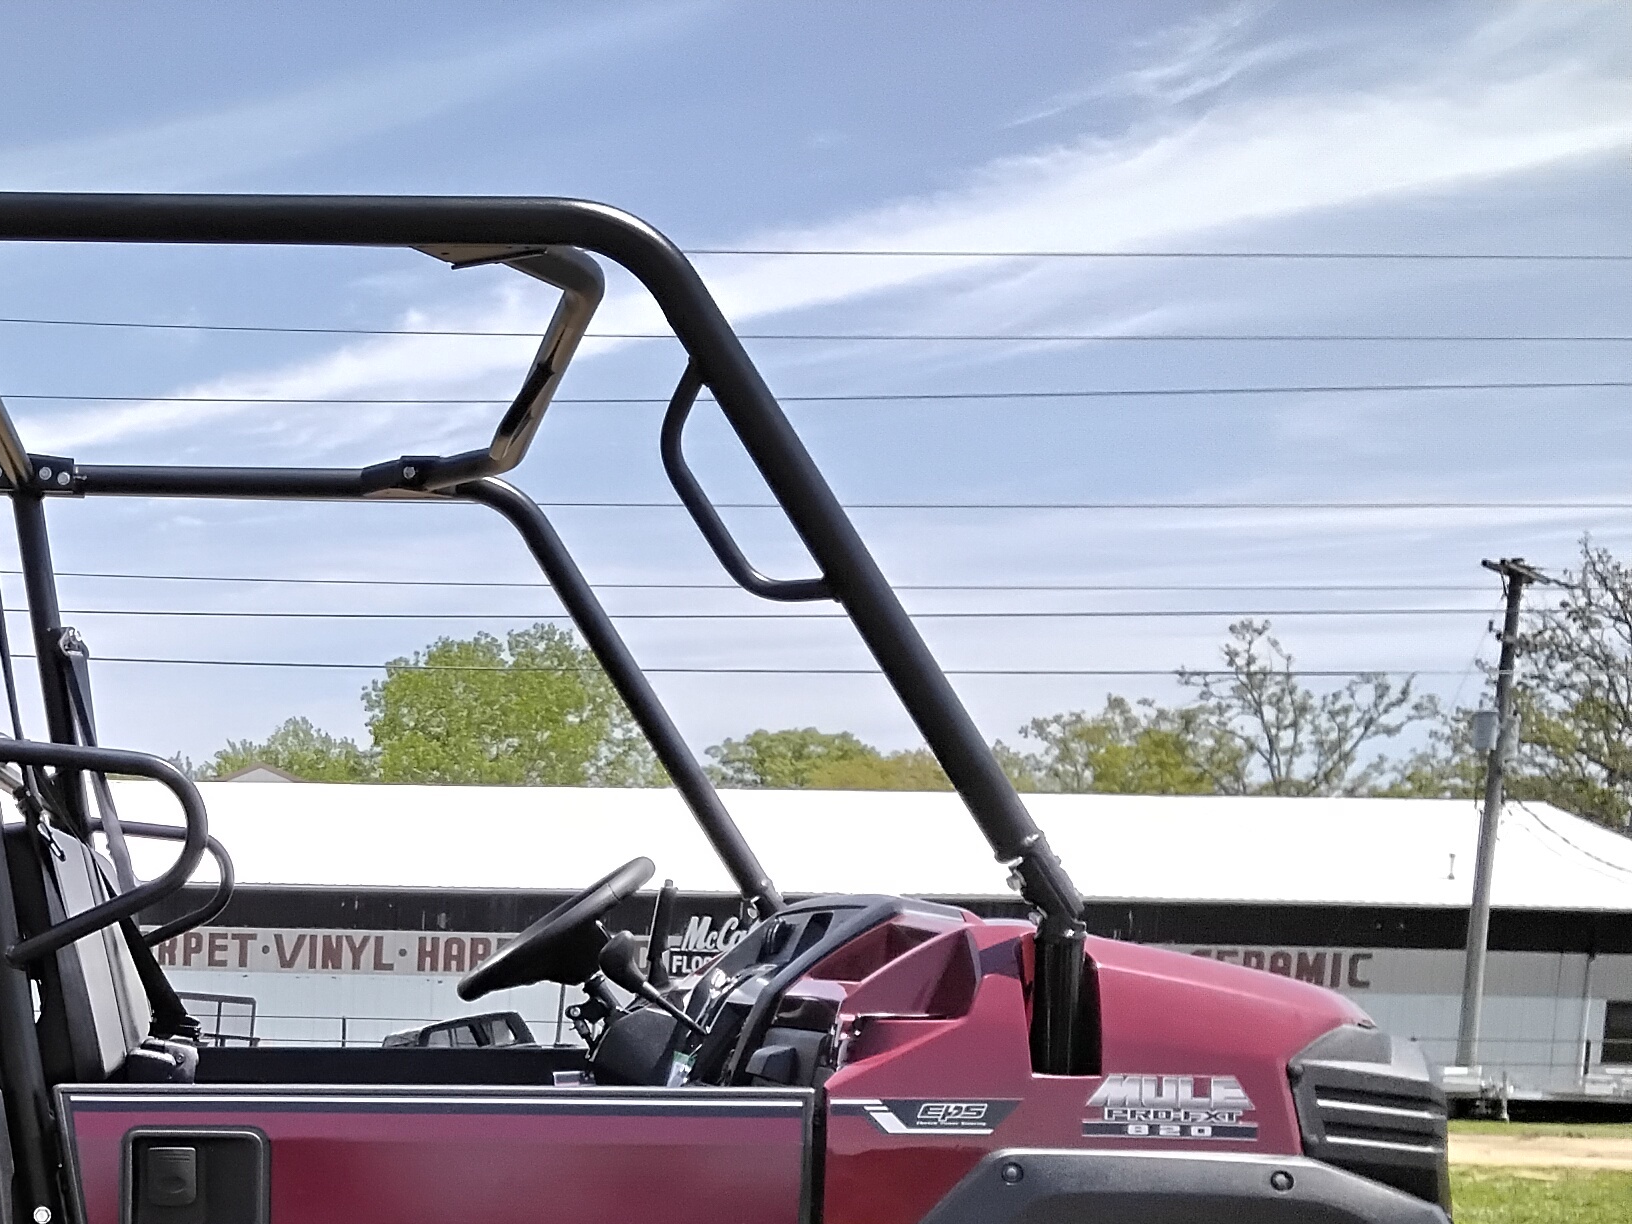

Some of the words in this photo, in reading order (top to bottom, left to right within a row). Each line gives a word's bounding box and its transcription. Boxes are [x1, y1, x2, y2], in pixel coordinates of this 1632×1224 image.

[680, 915, 760, 951] McCa
[158, 931, 258, 968] RPET
[274, 933, 395, 970] VINYL
[417, 936, 513, 972] HAR
[671, 955, 713, 973] FLO
[1085, 1073, 1256, 1110] MULE
[917, 1103, 988, 1121] EPS
[1127, 1124, 1212, 1137] 820
